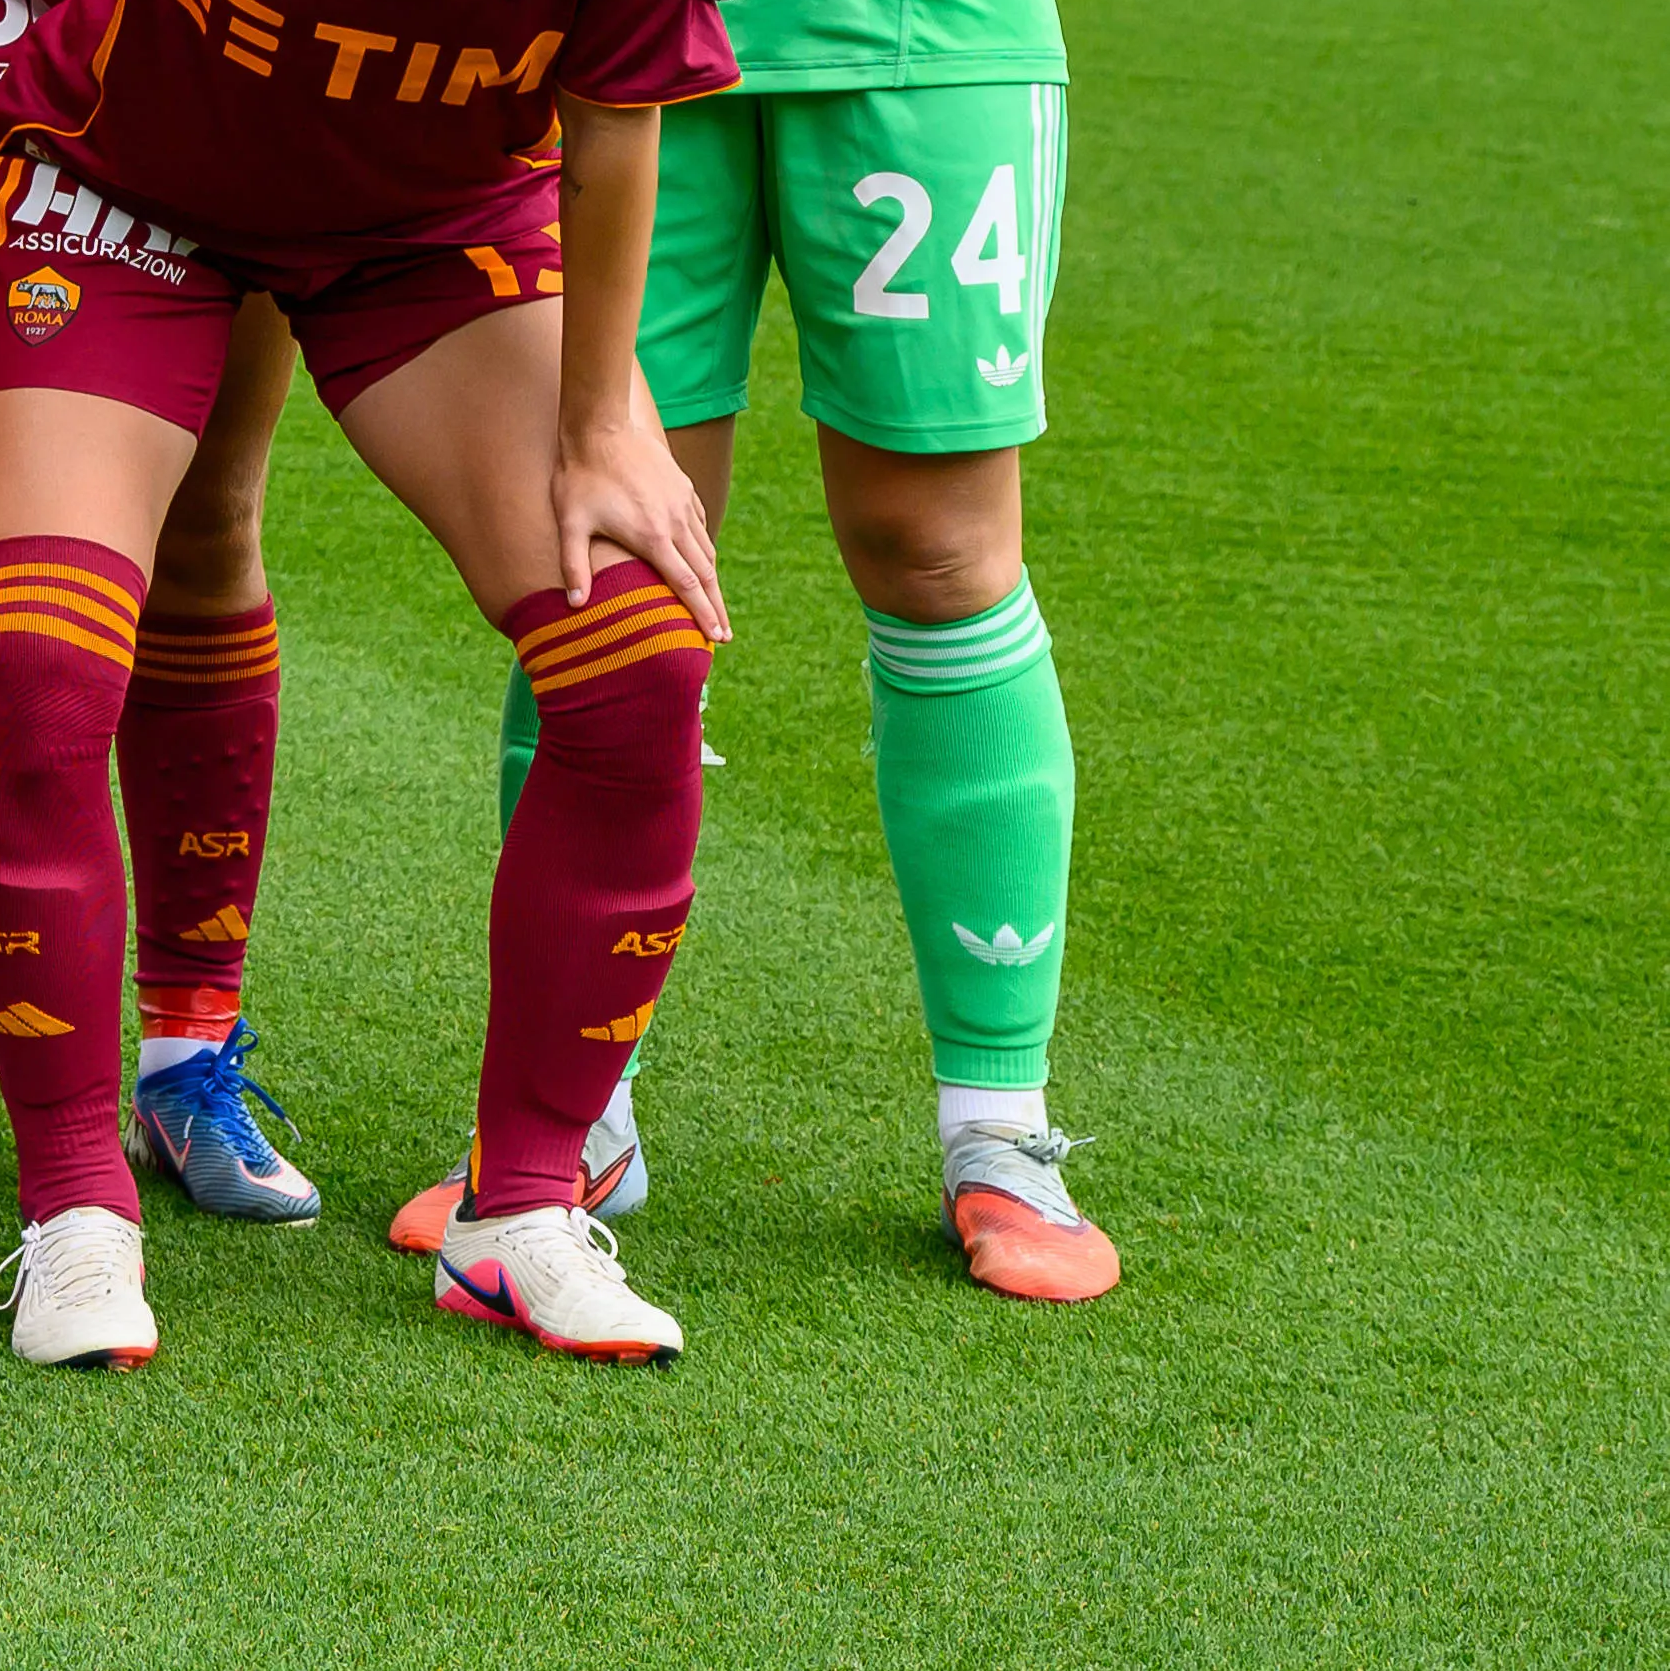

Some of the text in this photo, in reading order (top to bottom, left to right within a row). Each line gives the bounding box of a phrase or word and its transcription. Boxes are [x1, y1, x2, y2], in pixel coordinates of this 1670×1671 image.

[315, 22, 564, 106] TIM
[9, 233, 187, 285] ASSICURAZIONI
[853, 165, 1026, 319] 24
[13, 309, 65, 328] ROMA
[25, 328, 46, 338] 1927
[179, 830, 250, 858] ASR
